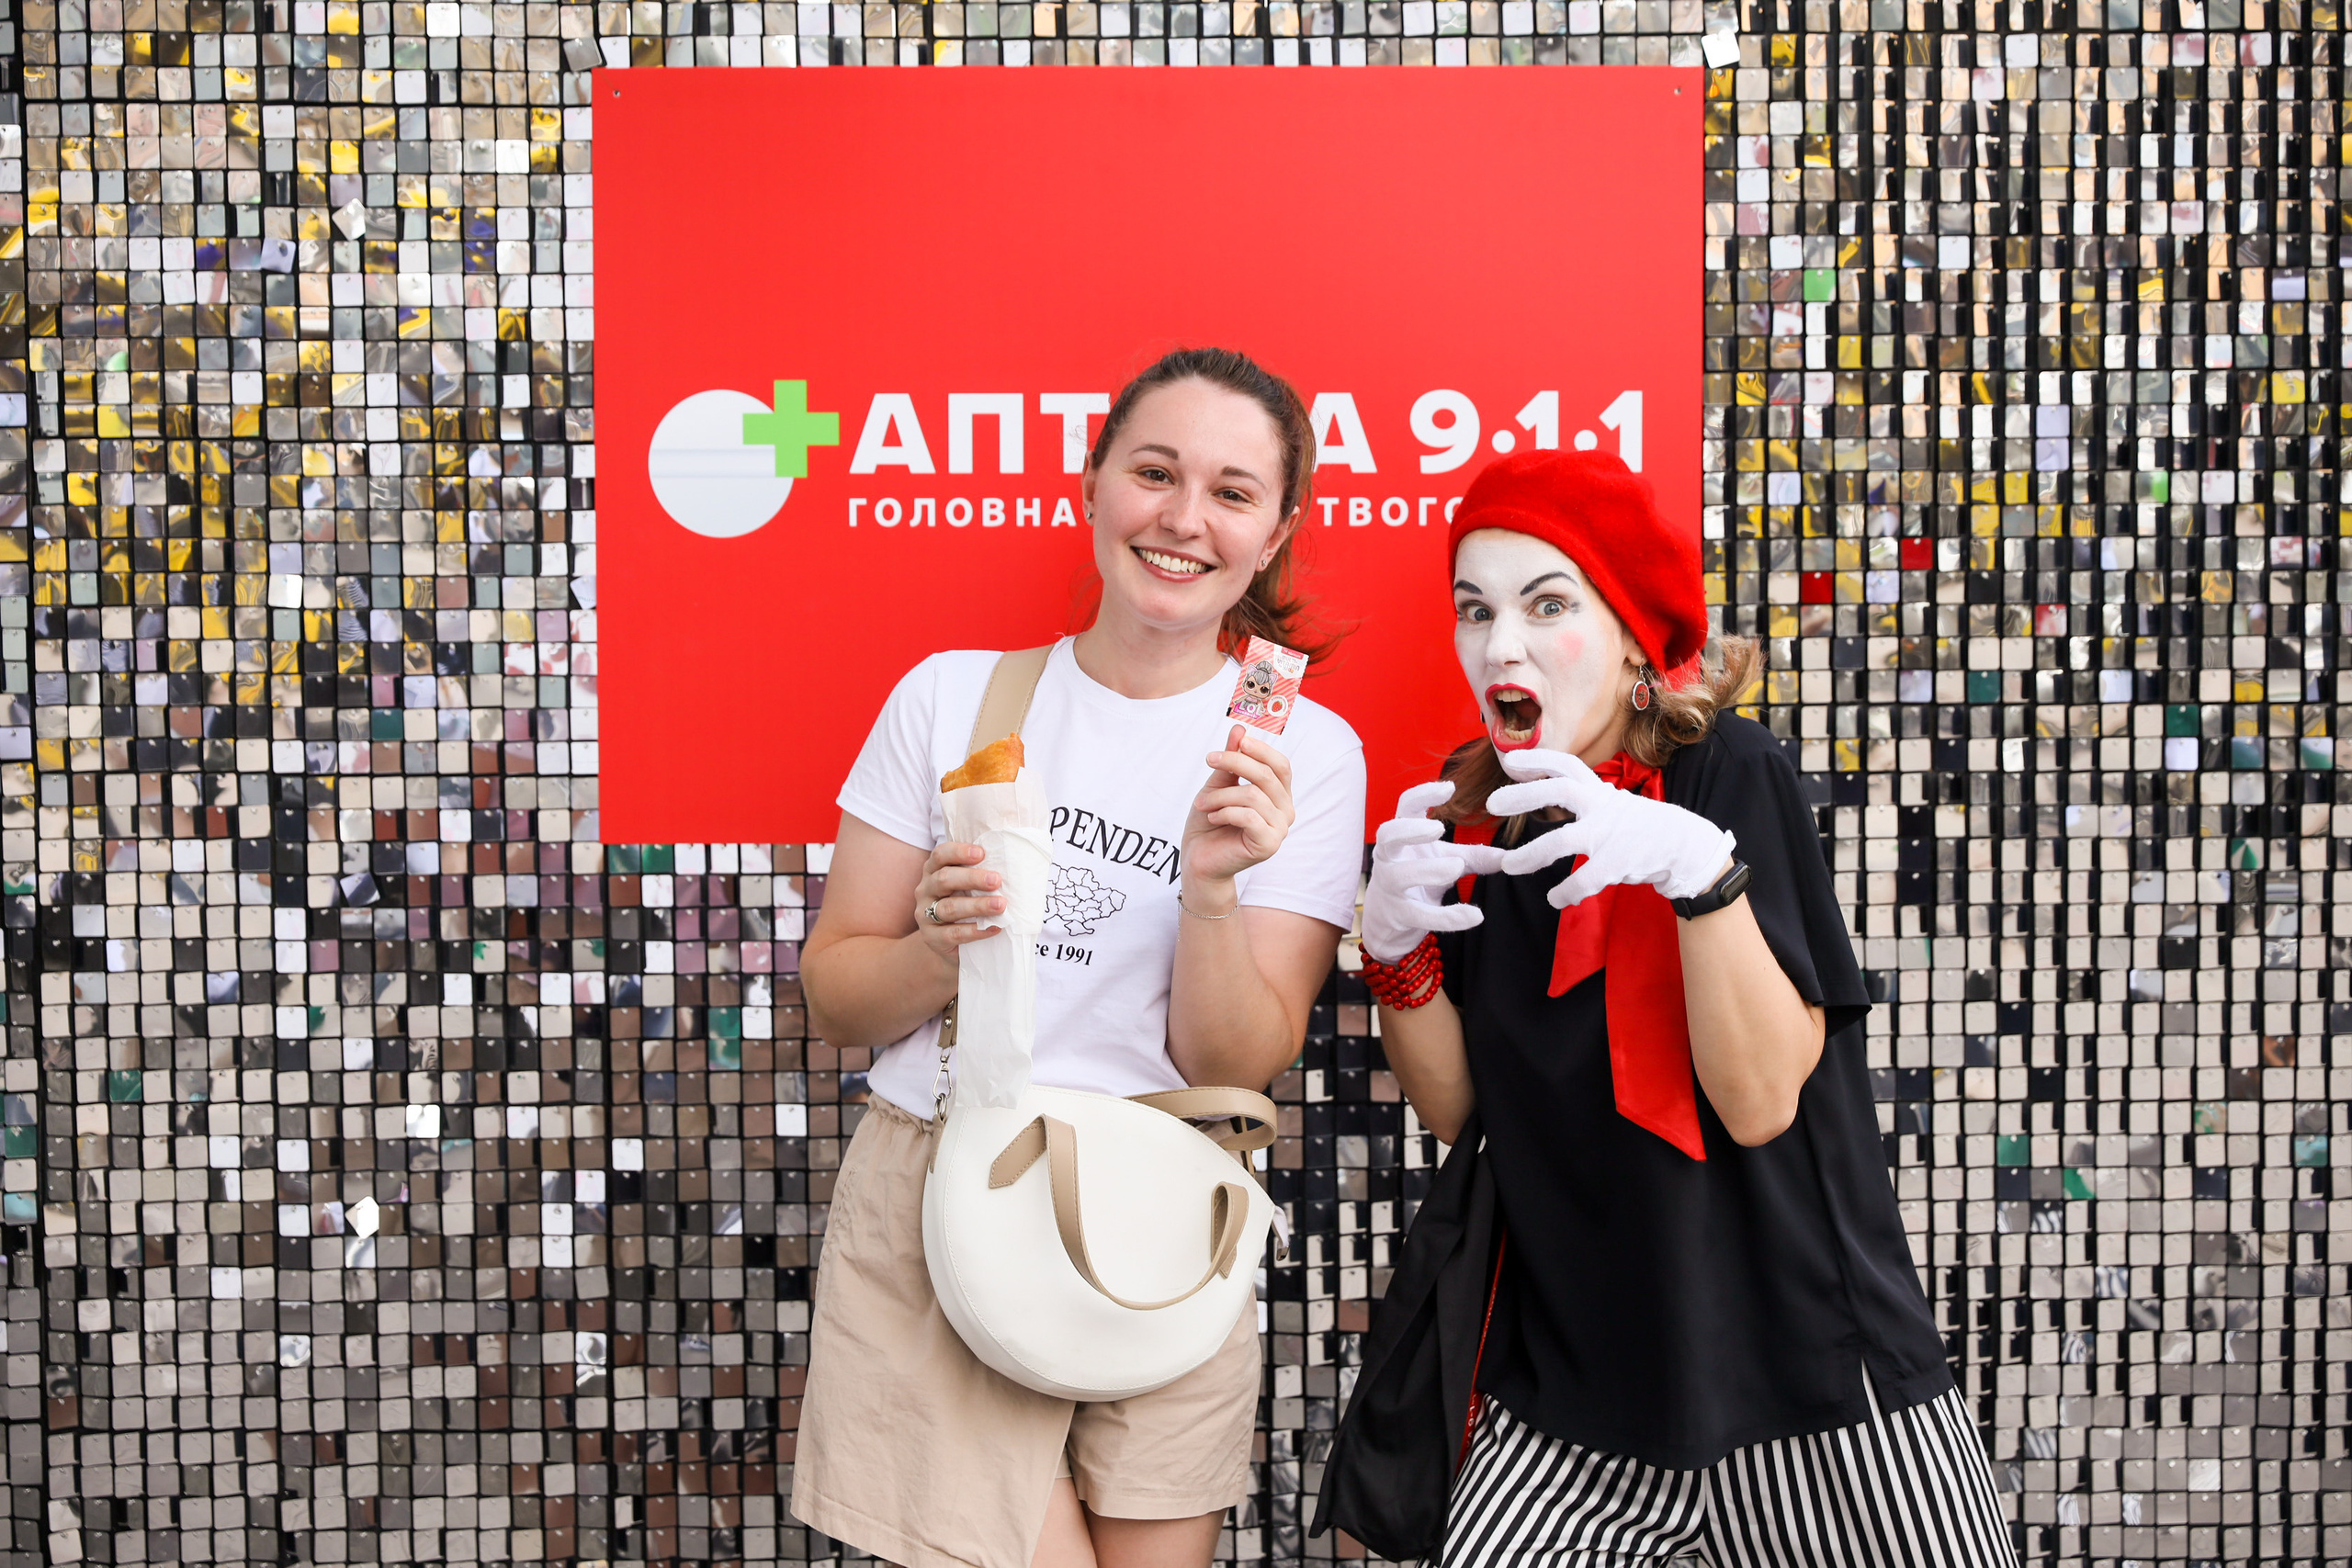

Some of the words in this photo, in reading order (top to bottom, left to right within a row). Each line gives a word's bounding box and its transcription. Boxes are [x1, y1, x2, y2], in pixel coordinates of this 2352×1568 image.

[849, 392, 1377, 474] АПТА
[848, 497, 1077, 527] ГОЛОВНА
[1050, 806, 1181, 886] PENDEN
[1056, 943, 1093, 966] 1991
